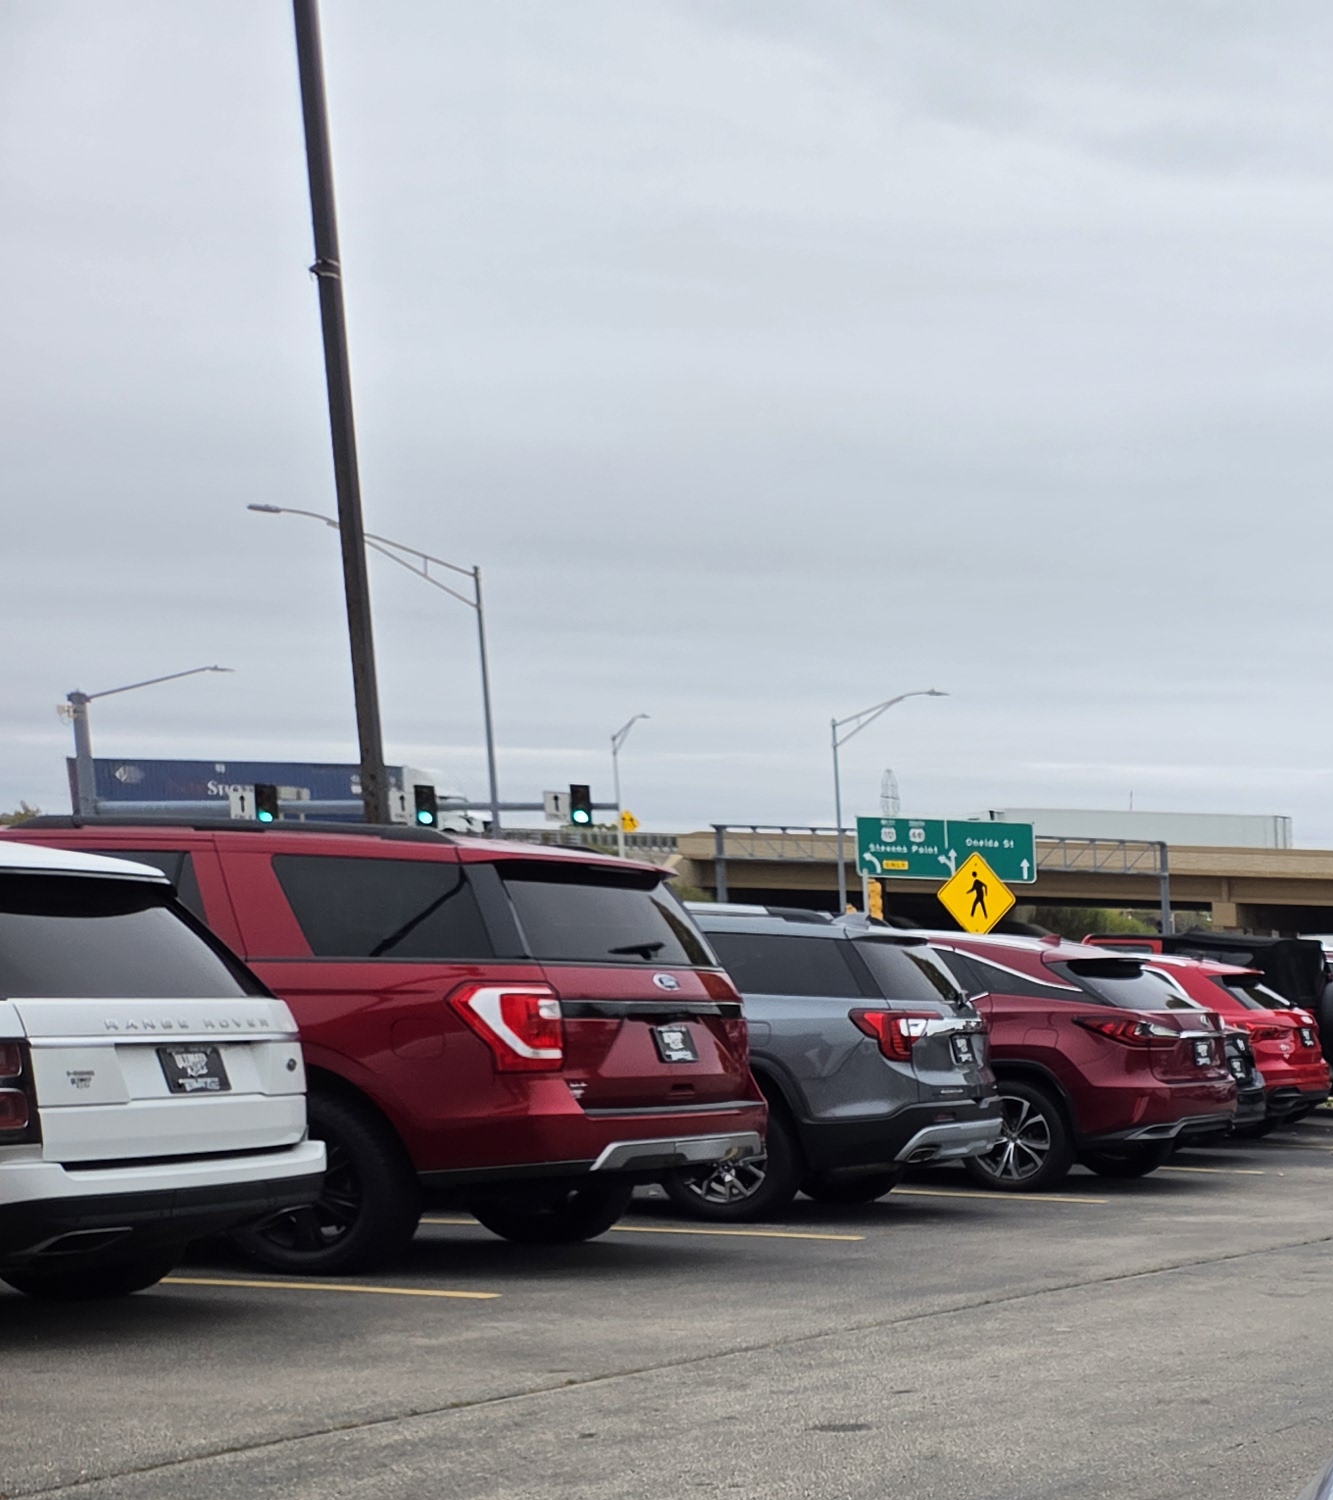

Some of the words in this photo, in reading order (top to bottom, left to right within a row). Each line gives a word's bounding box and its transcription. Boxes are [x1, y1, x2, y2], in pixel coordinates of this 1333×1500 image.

[965, 837, 999, 848] Oneida
[1003, 838, 1015, 848] St
[869, 843, 908, 854] Stevens
[911, 844, 938, 854] Point
[104, 1018, 190, 1030] RANGE
[203, 1018, 269, 1029] ROVER
